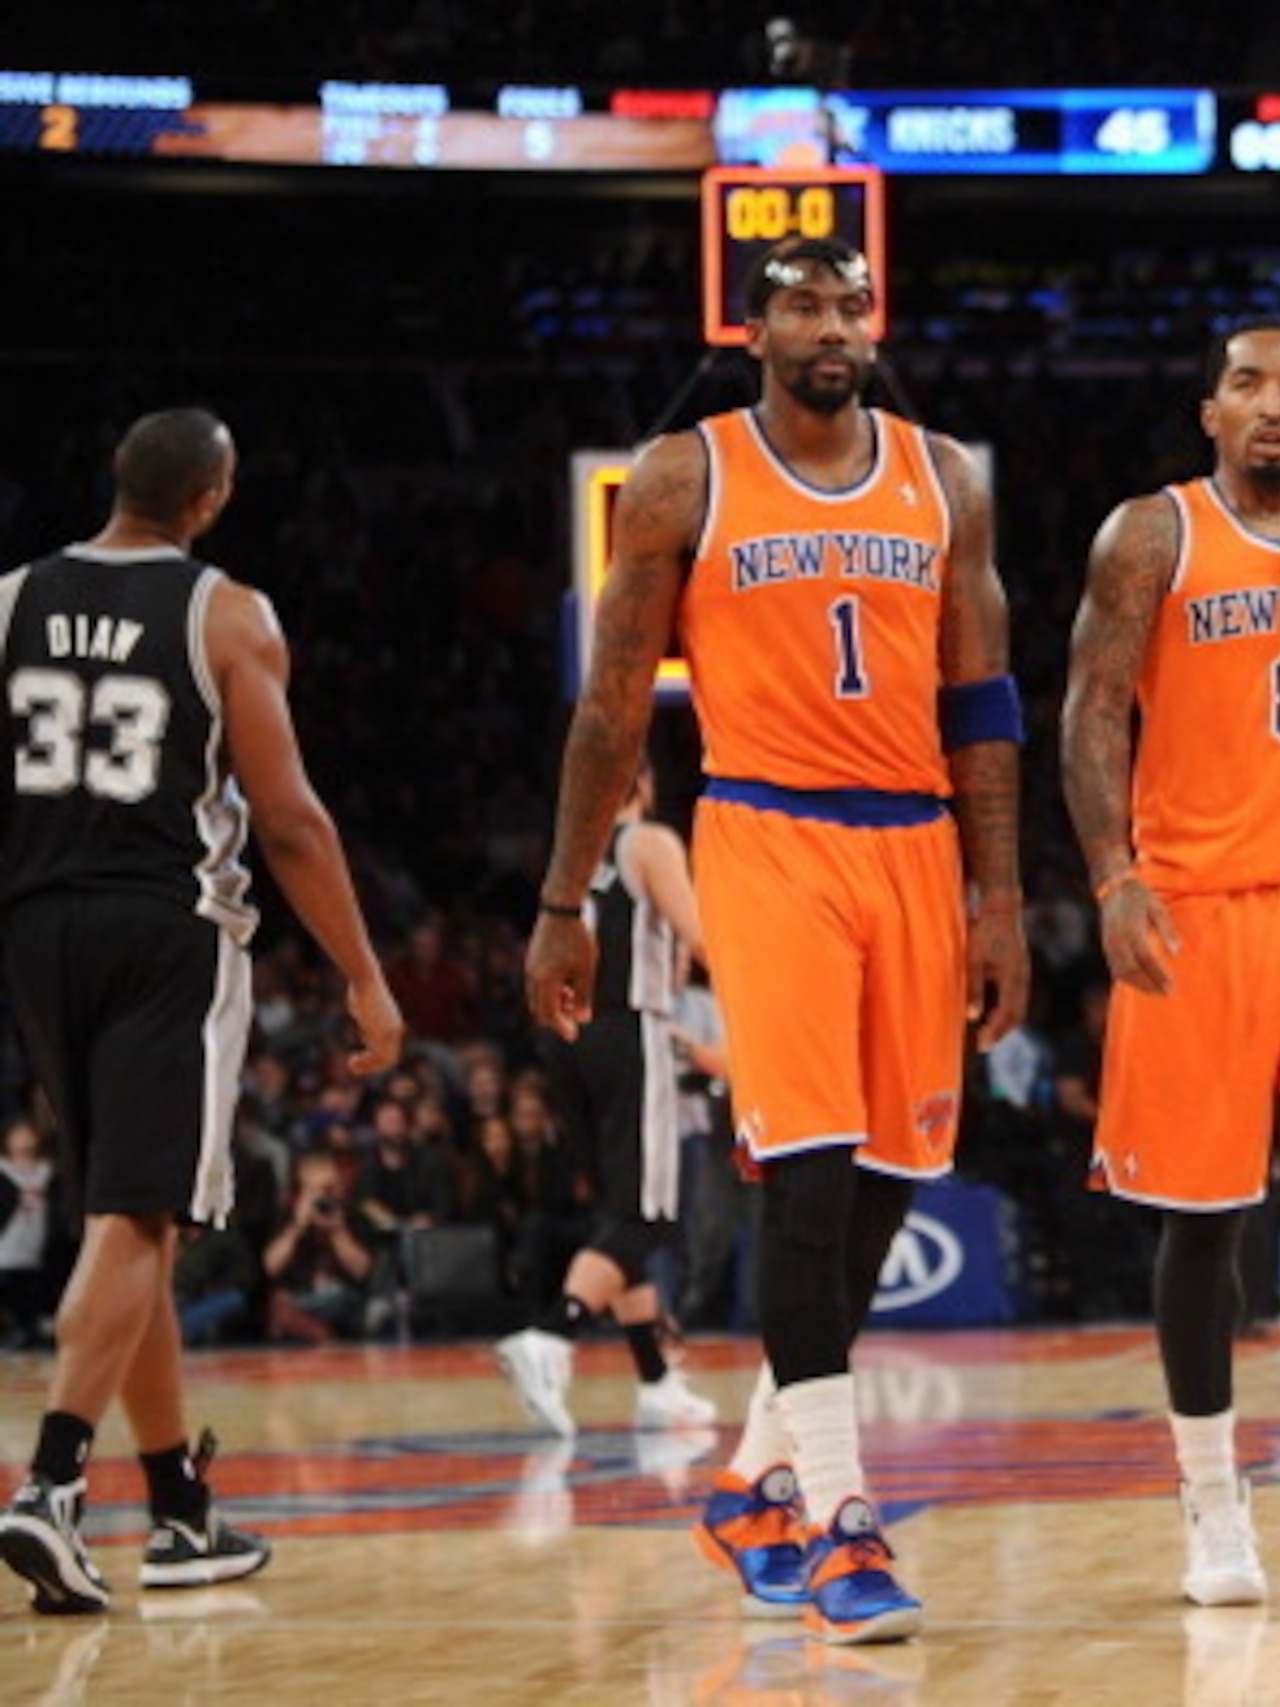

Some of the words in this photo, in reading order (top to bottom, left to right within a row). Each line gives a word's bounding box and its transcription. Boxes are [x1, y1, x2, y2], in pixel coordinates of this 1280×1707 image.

[39, 104, 78, 150] 2
[728, 531, 826, 593] NEW
[827, 529, 941, 593] YORK
[826, 593, 869, 700] 1
[1186, 586, 1277, 646] NEW
[7, 664, 173, 805] 33
